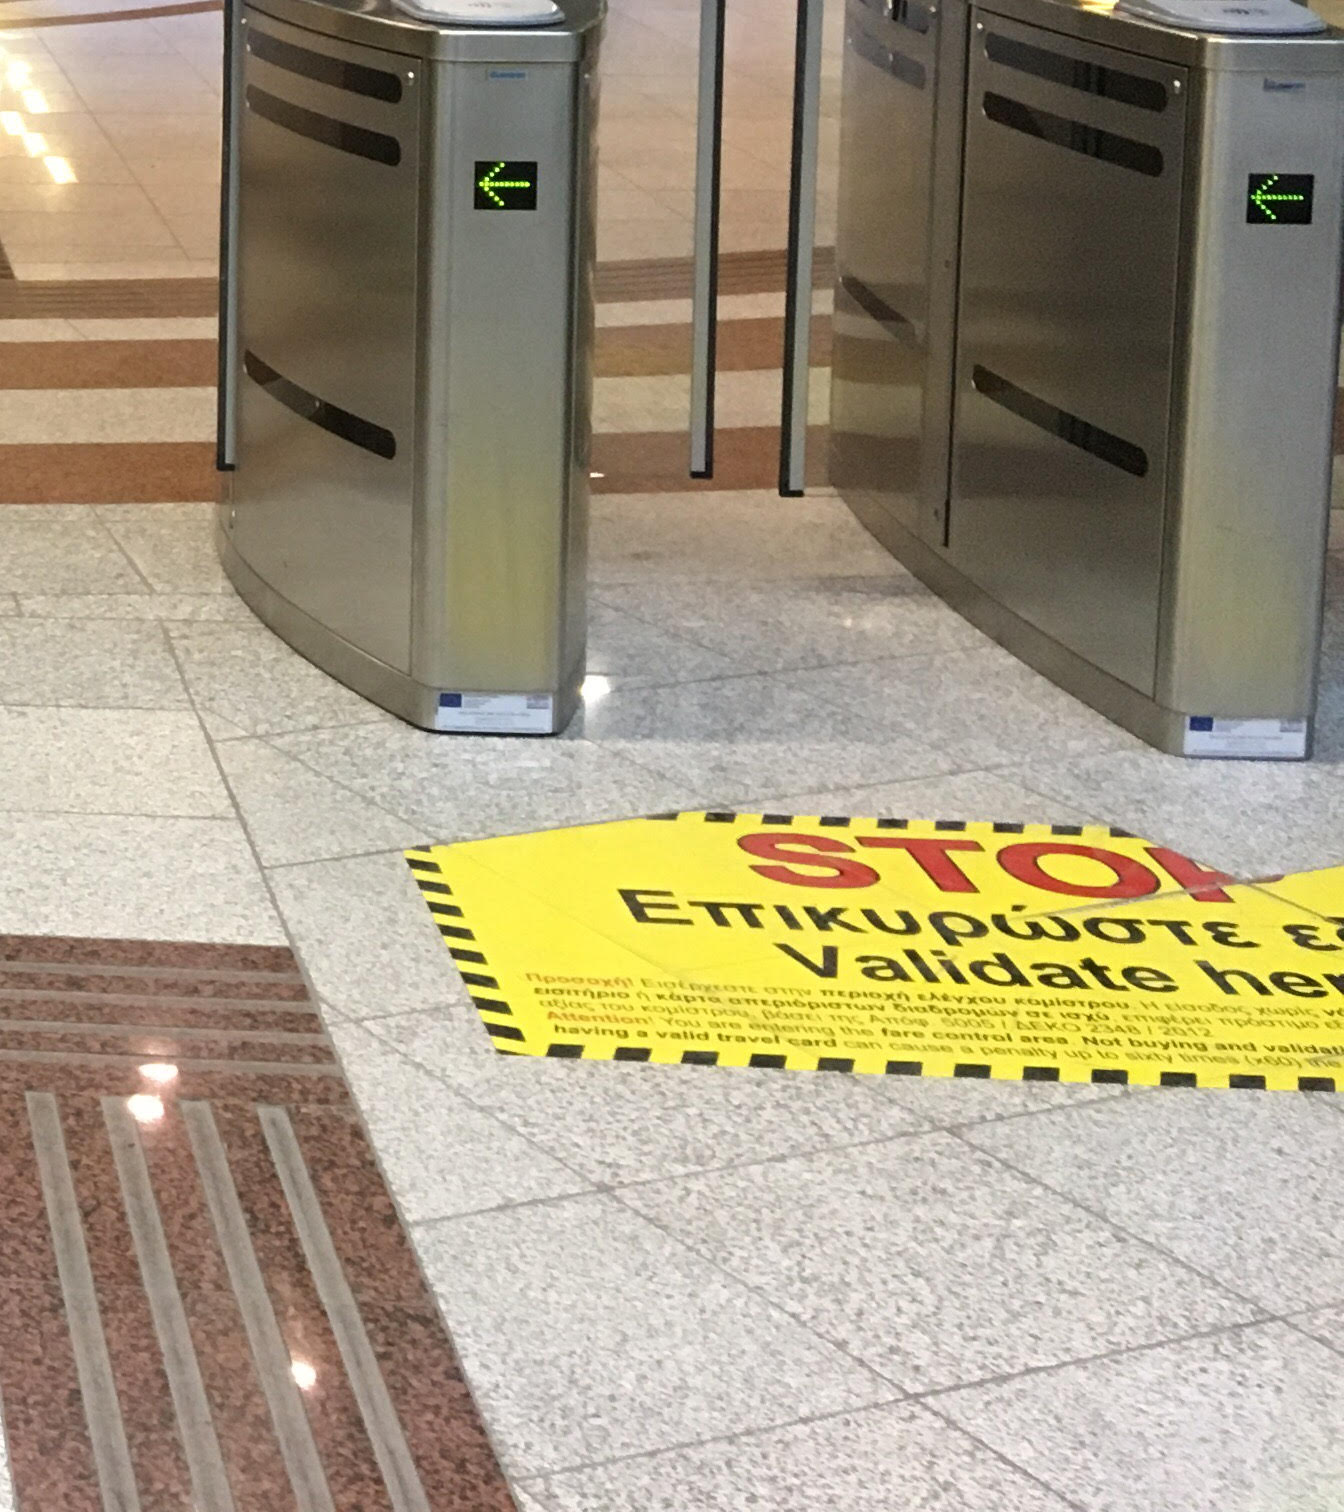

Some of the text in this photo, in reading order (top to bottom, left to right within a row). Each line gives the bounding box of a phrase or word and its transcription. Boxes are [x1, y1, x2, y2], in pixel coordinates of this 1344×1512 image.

[617, 888, 1261, 950] Επικυρώστε
[773, 943, 1180, 994] Validate
[547, 1010, 653, 1025] Attention!
[658, 1016, 701, 1027] You
[708, 1021, 742, 1029] are
[748, 1021, 835, 1036] entering
[839, 1025, 874, 1036] the
[881, 1027, 925, 1038] fare
[932, 1029, 1012, 1042] control
[1081, 1035, 1122, 1047] Not
[1127, 1038, 1208, 1052] buying
[1214, 1040, 1257, 1052] and
[554, 1024, 629, 1039] having
[655, 1029, 709, 1040] valid
[717, 1032, 779, 1043] travel
[787, 1036, 837, 1047] card
[843, 1040, 882, 1049] can
[889, 1042, 953, 1052] cause
[979, 1044, 1057, 1059] penalty
[1063, 1049, 1092, 1060] up
[1097, 1050, 1119, 1059] to
